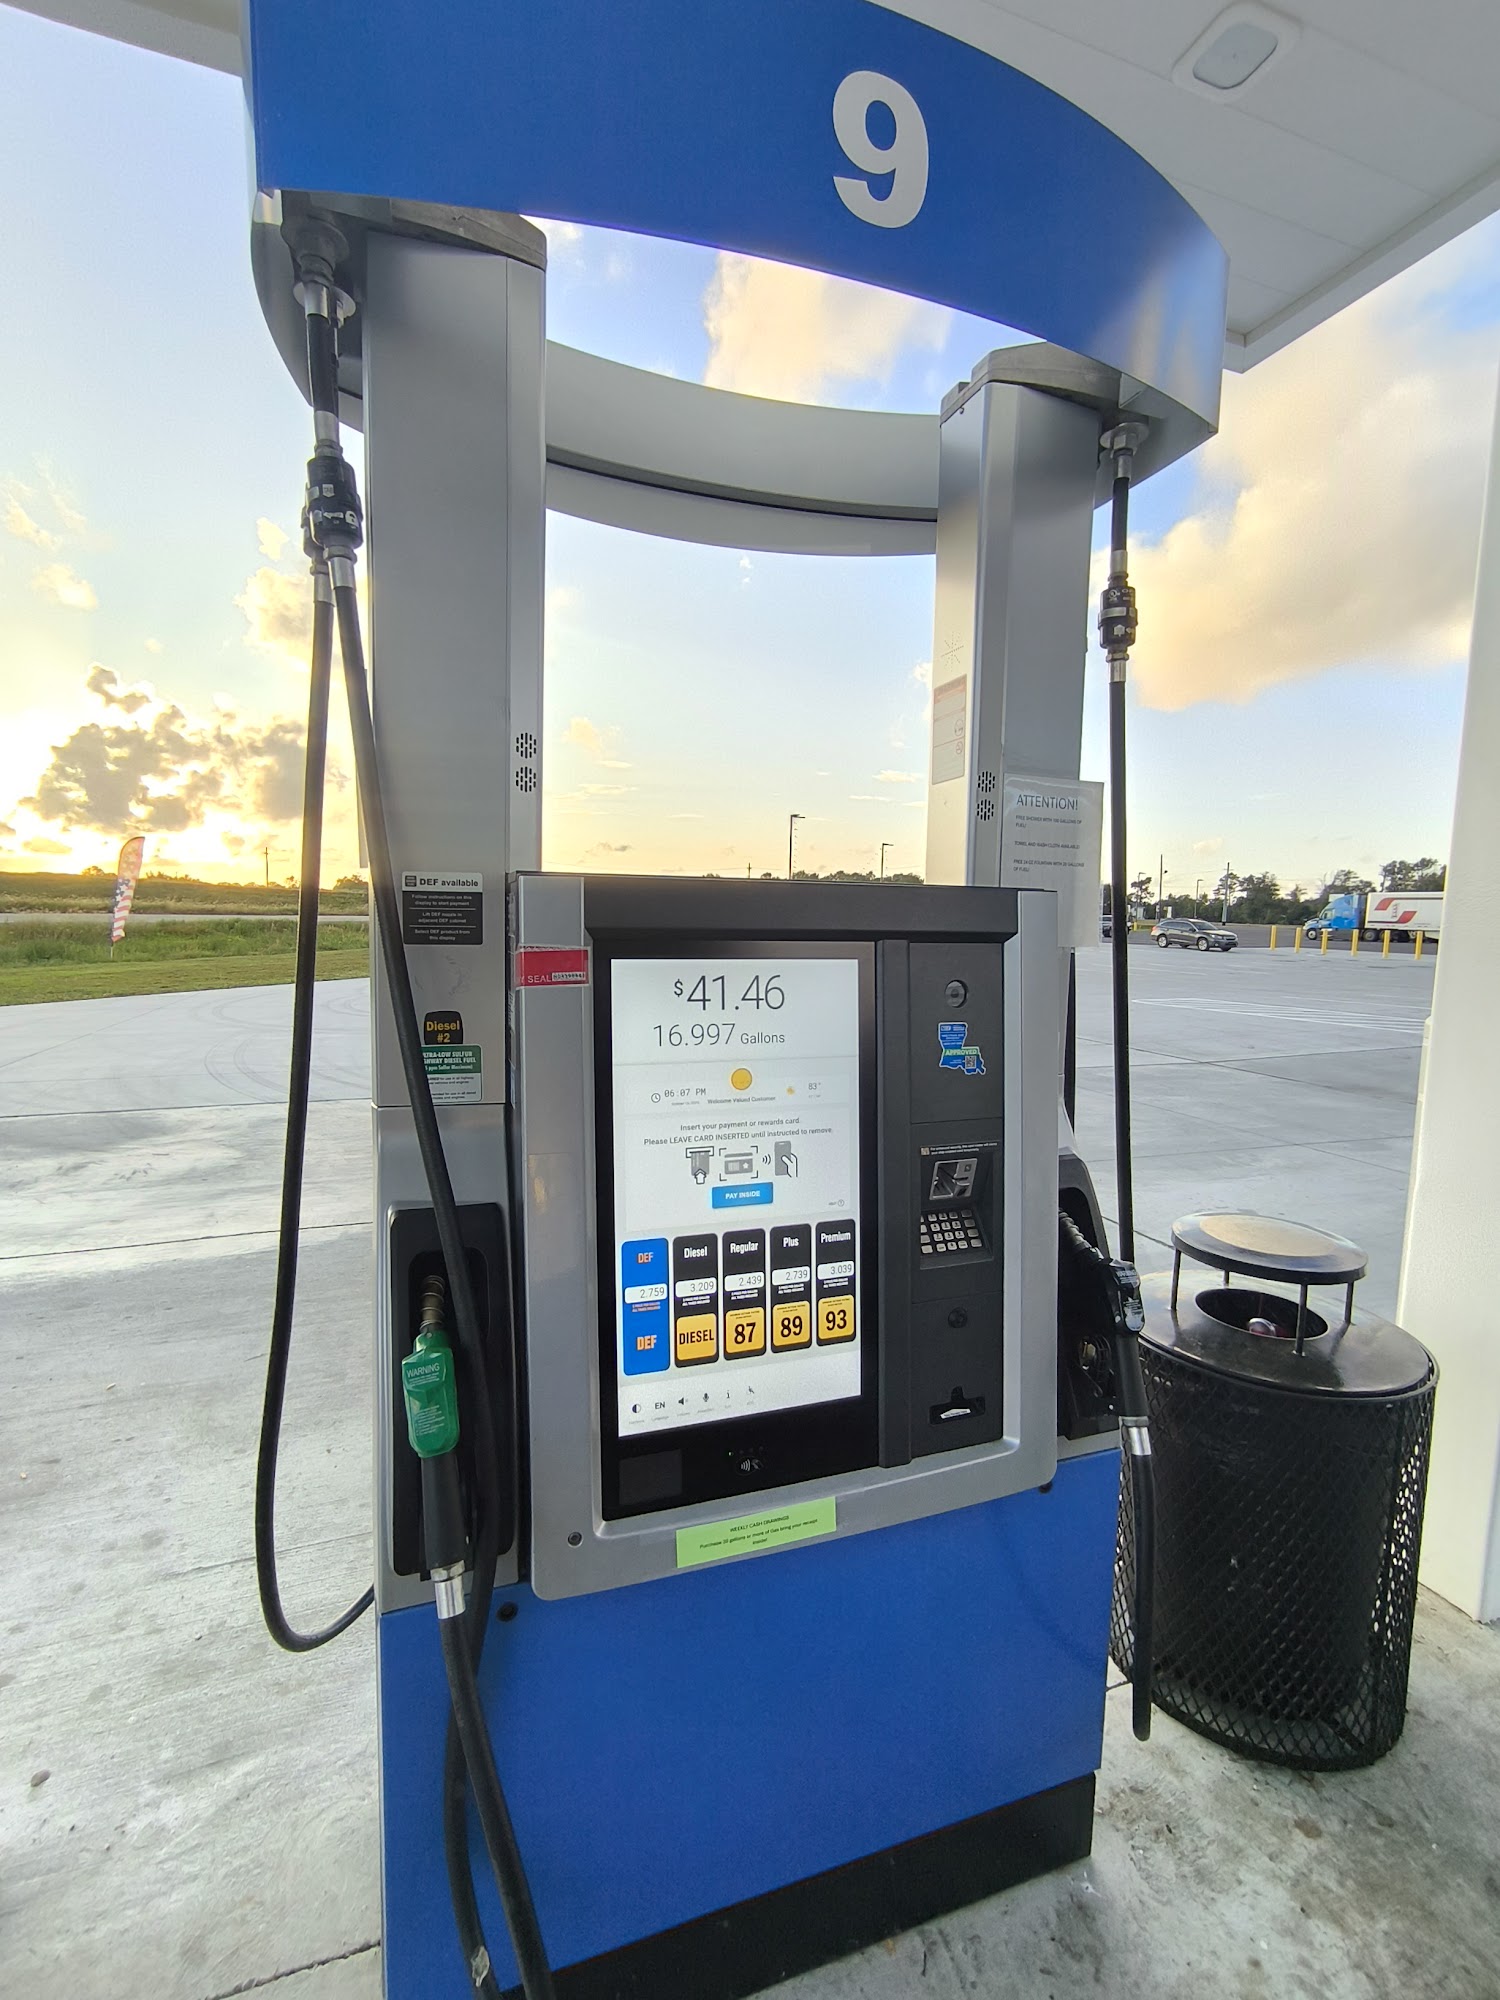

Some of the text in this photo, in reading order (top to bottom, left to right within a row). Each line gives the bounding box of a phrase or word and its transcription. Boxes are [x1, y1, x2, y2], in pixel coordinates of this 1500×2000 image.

[832, 70, 929, 229] 9
[1016, 794, 1078, 811] ATTENTION!
[420, 878, 479, 887] DEF available
[528, 975, 552, 983] SEAL
[673, 974, 786, 1011] $41.46
[426, 1020, 460, 1031] Diesel
[437, 1033, 451, 1043] #2
[653, 1022, 786, 1047] 16.997 Gallons
[944, 1048, 978, 1056] APPROVED
[664, 1087, 707, 1098] 06:07 PM
[702, 1123, 718, 1132] your
[718, 1121, 748, 1131] payment
[757, 1118, 784, 1126] rewards
[643, 1138, 668, 1146] Please
[669, 1135, 692, 1144] LEAVE
[694, 1134, 714, 1143] CARD
[715, 1132, 750, 1141] INSERTED
[751, 1131, 766, 1139] until
[767, 1129, 800, 1137] instructed
[725, 1190, 761, 1200] PAY INSIDE
[783, 1236, 799, 1248] Plus
[820, 1231, 851, 1243] Premium
[684, 1245, 708, 1259] Diesel
[730, 1241, 759, 1254] Regular
[637, 1252, 654, 1264] DEF
[785, 1269, 808, 1281] 2.739
[830, 1263, 853, 1275] 3.039
[690, 1280, 715, 1293] 3.209
[738, 1275, 762, 1287] 2.439
[640, 1286, 665, 1299] 2.759
[780, 1315, 803, 1338] 89
[825, 1309, 848, 1331] 93
[679, 1328, 715, 1346] DIESEL
[734, 1322, 757, 1345] 87
[636, 1334, 658, 1351] DEF
[406, 1362, 440, 1378] WARNING
[654, 1401, 666, 1410] EN
